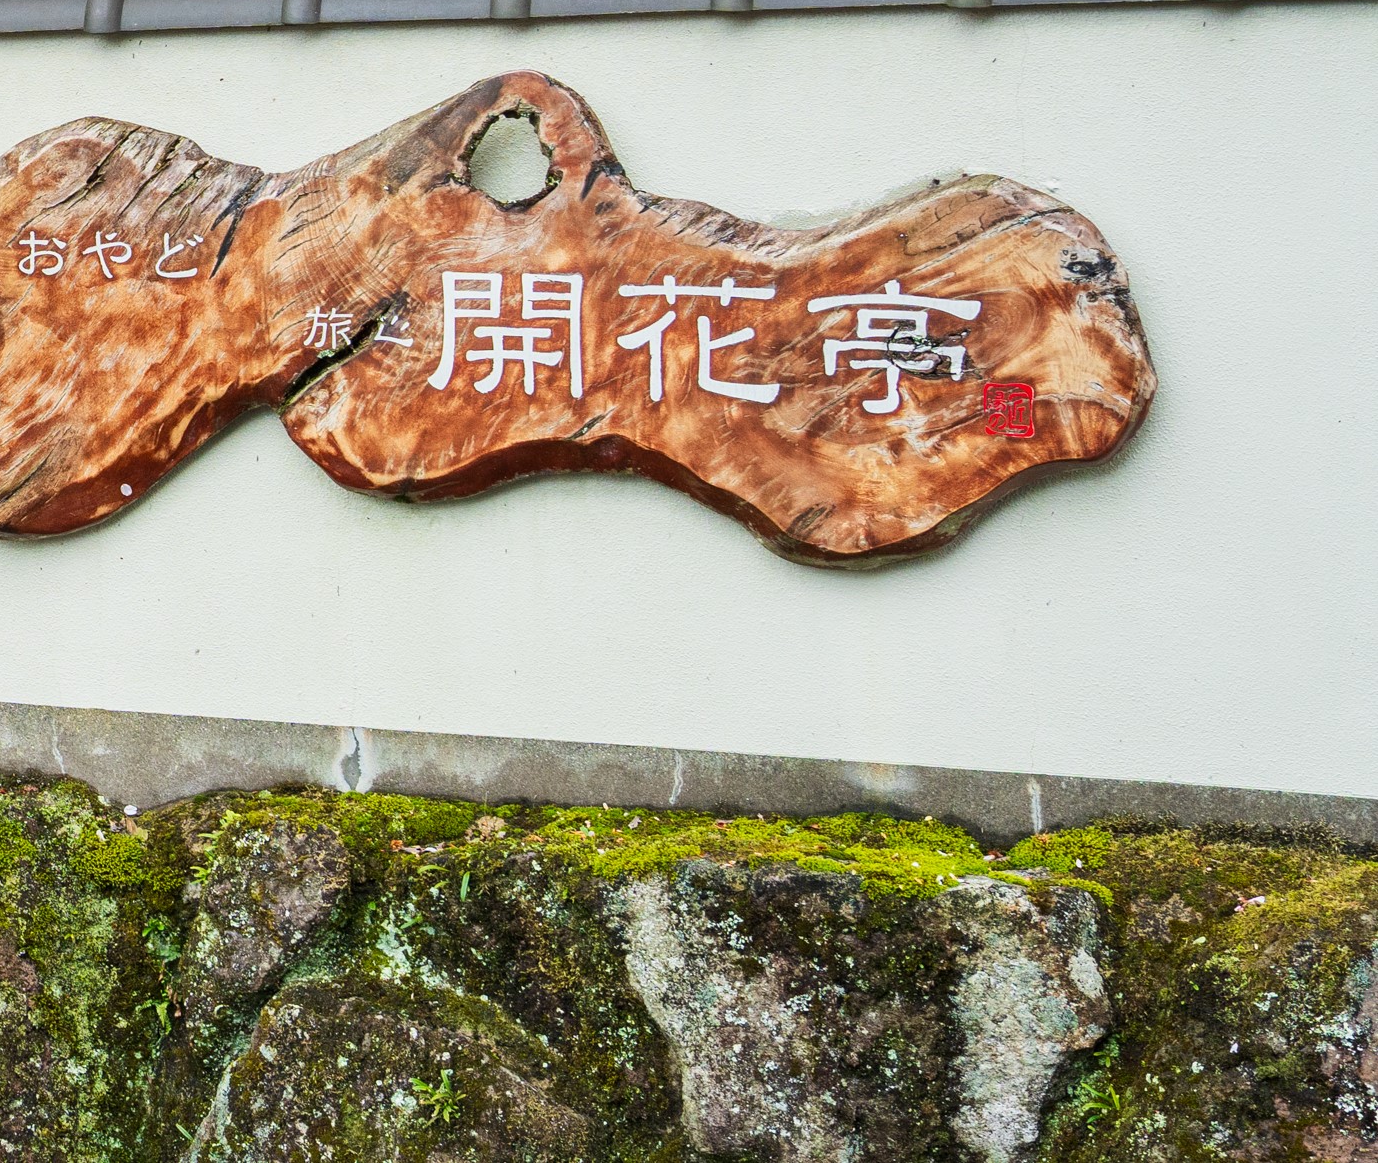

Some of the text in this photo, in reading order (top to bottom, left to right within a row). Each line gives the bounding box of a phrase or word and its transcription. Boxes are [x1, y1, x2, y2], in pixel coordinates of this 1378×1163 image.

[18, 230, 204, 279] おやど
[426, 271, 982, 414] 開花亭
